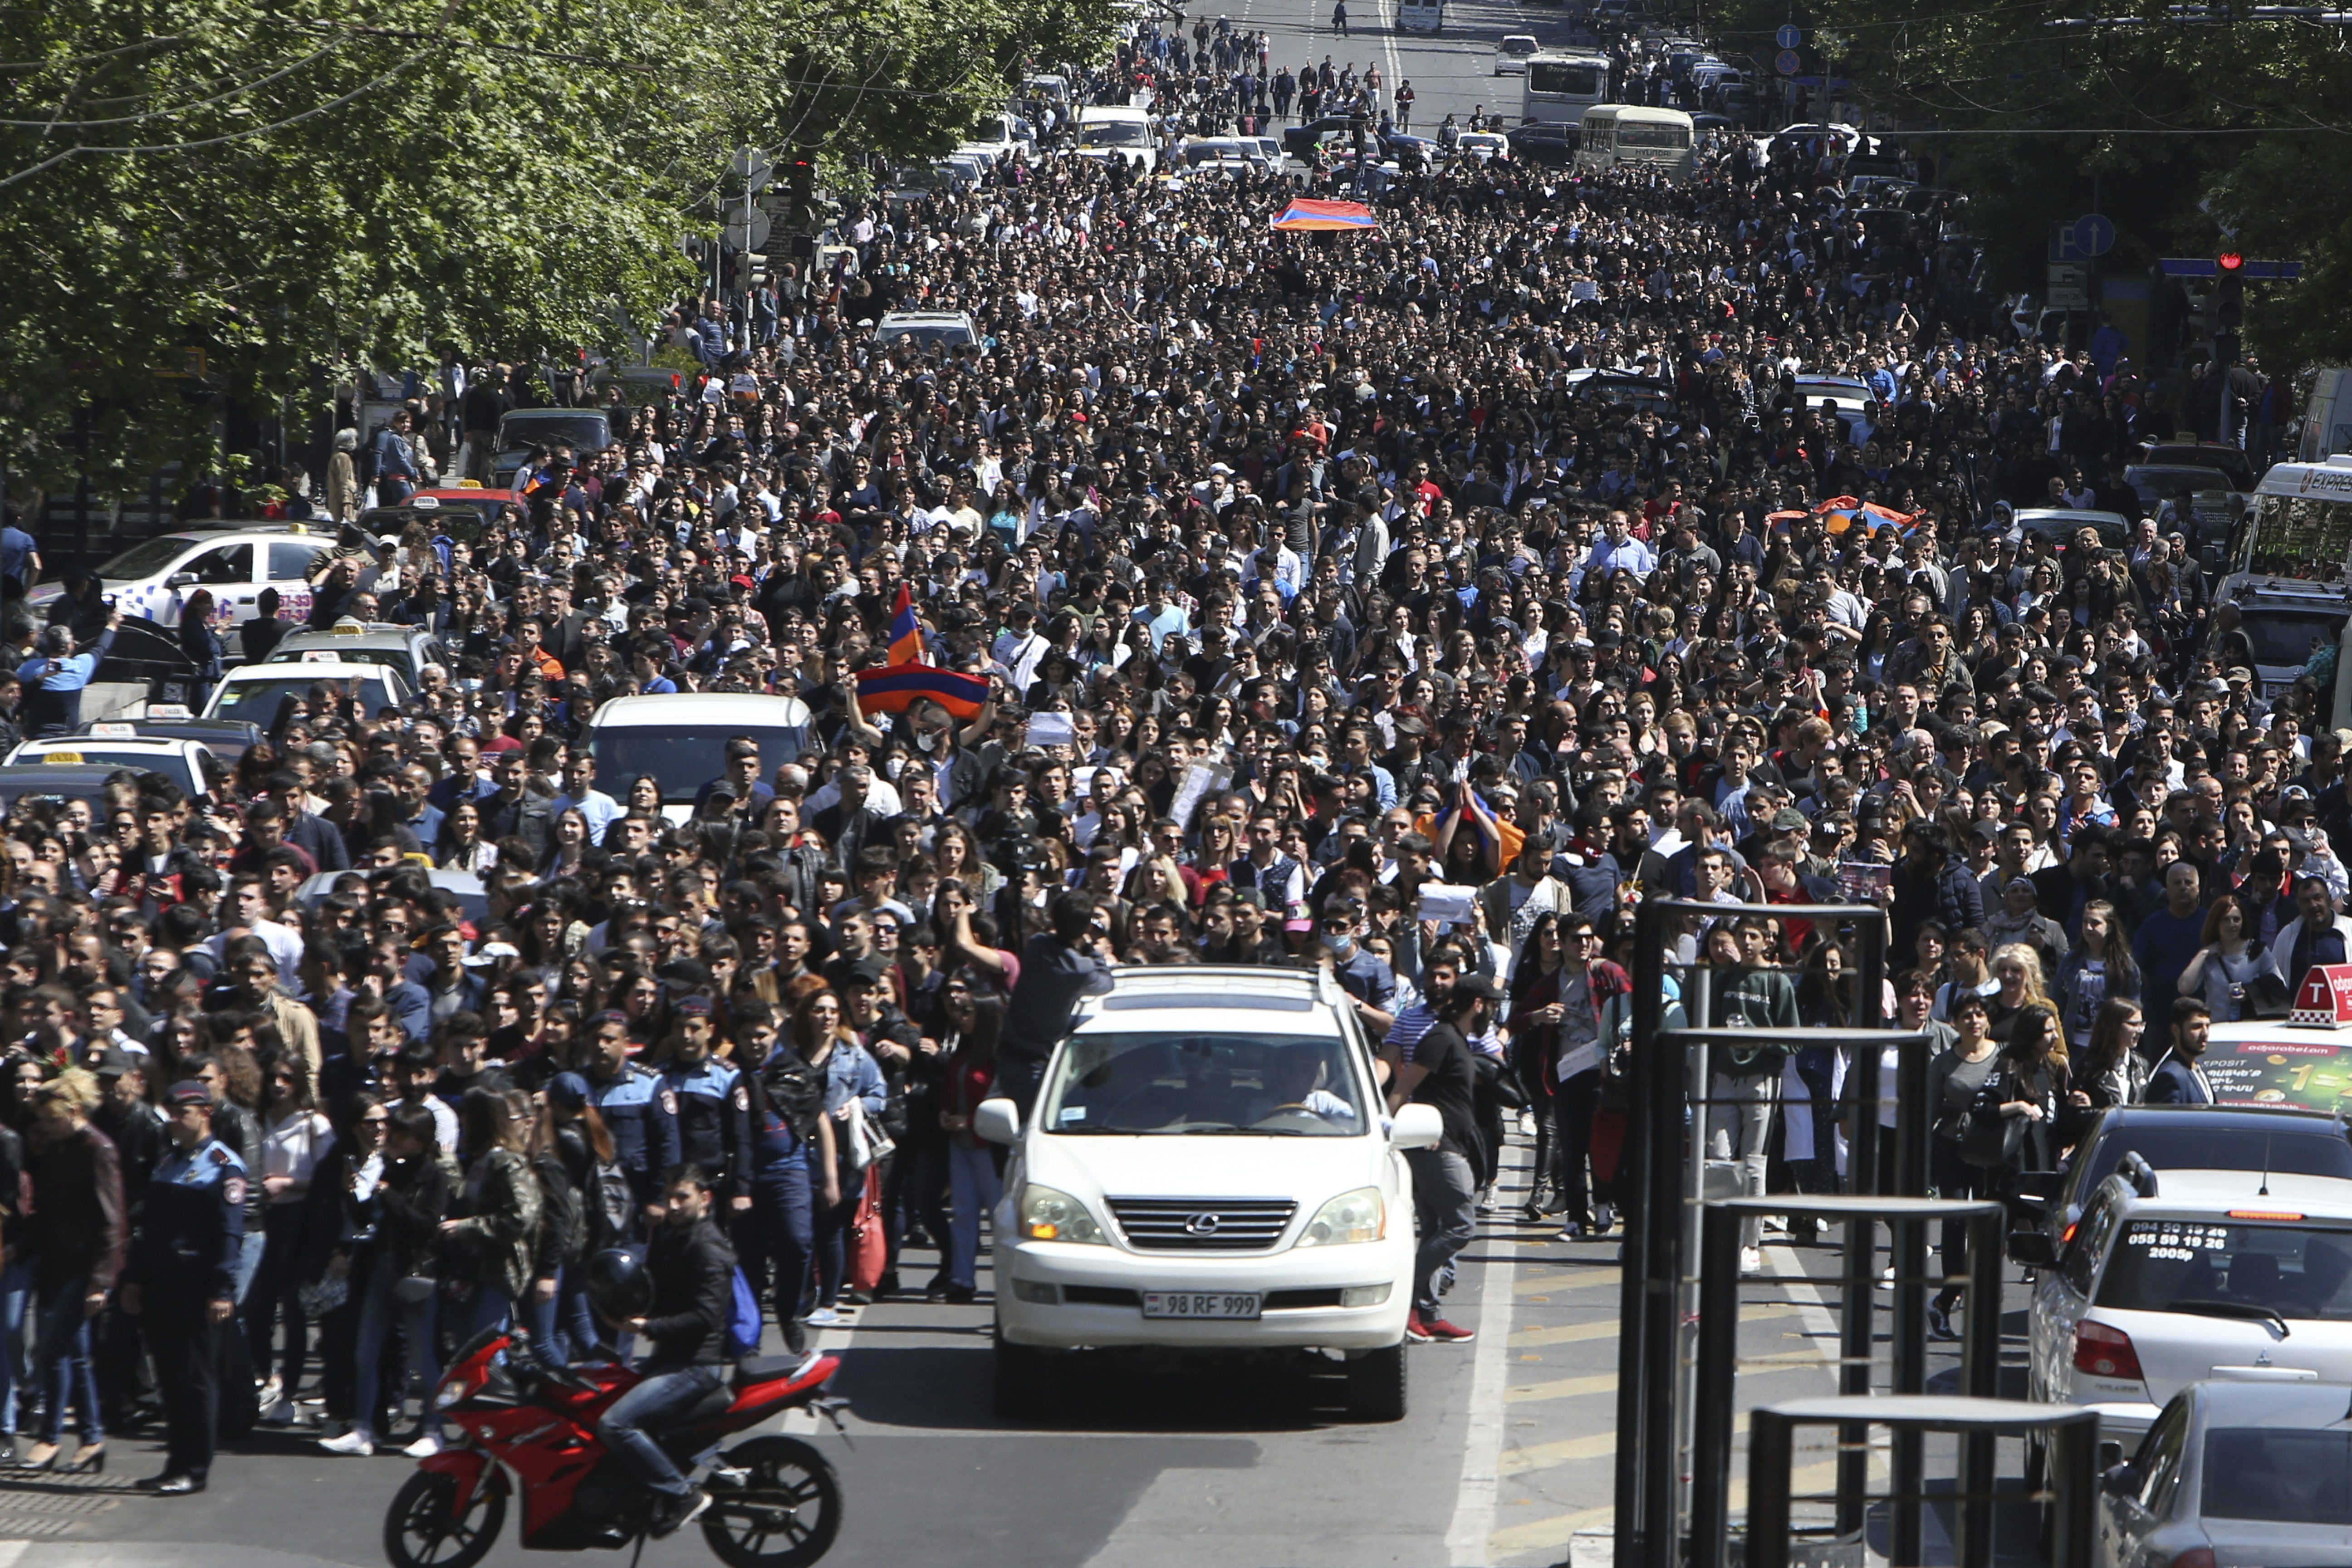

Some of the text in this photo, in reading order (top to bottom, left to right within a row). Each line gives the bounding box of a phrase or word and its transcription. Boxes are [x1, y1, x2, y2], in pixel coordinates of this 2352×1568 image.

[2059, 225, 2076, 258] P
[2308, 983, 2324, 1003] T
[2128, 1233, 2225, 1250] 055 59 19 26
[1168, 1296, 1254, 1314] 98 RF 999
